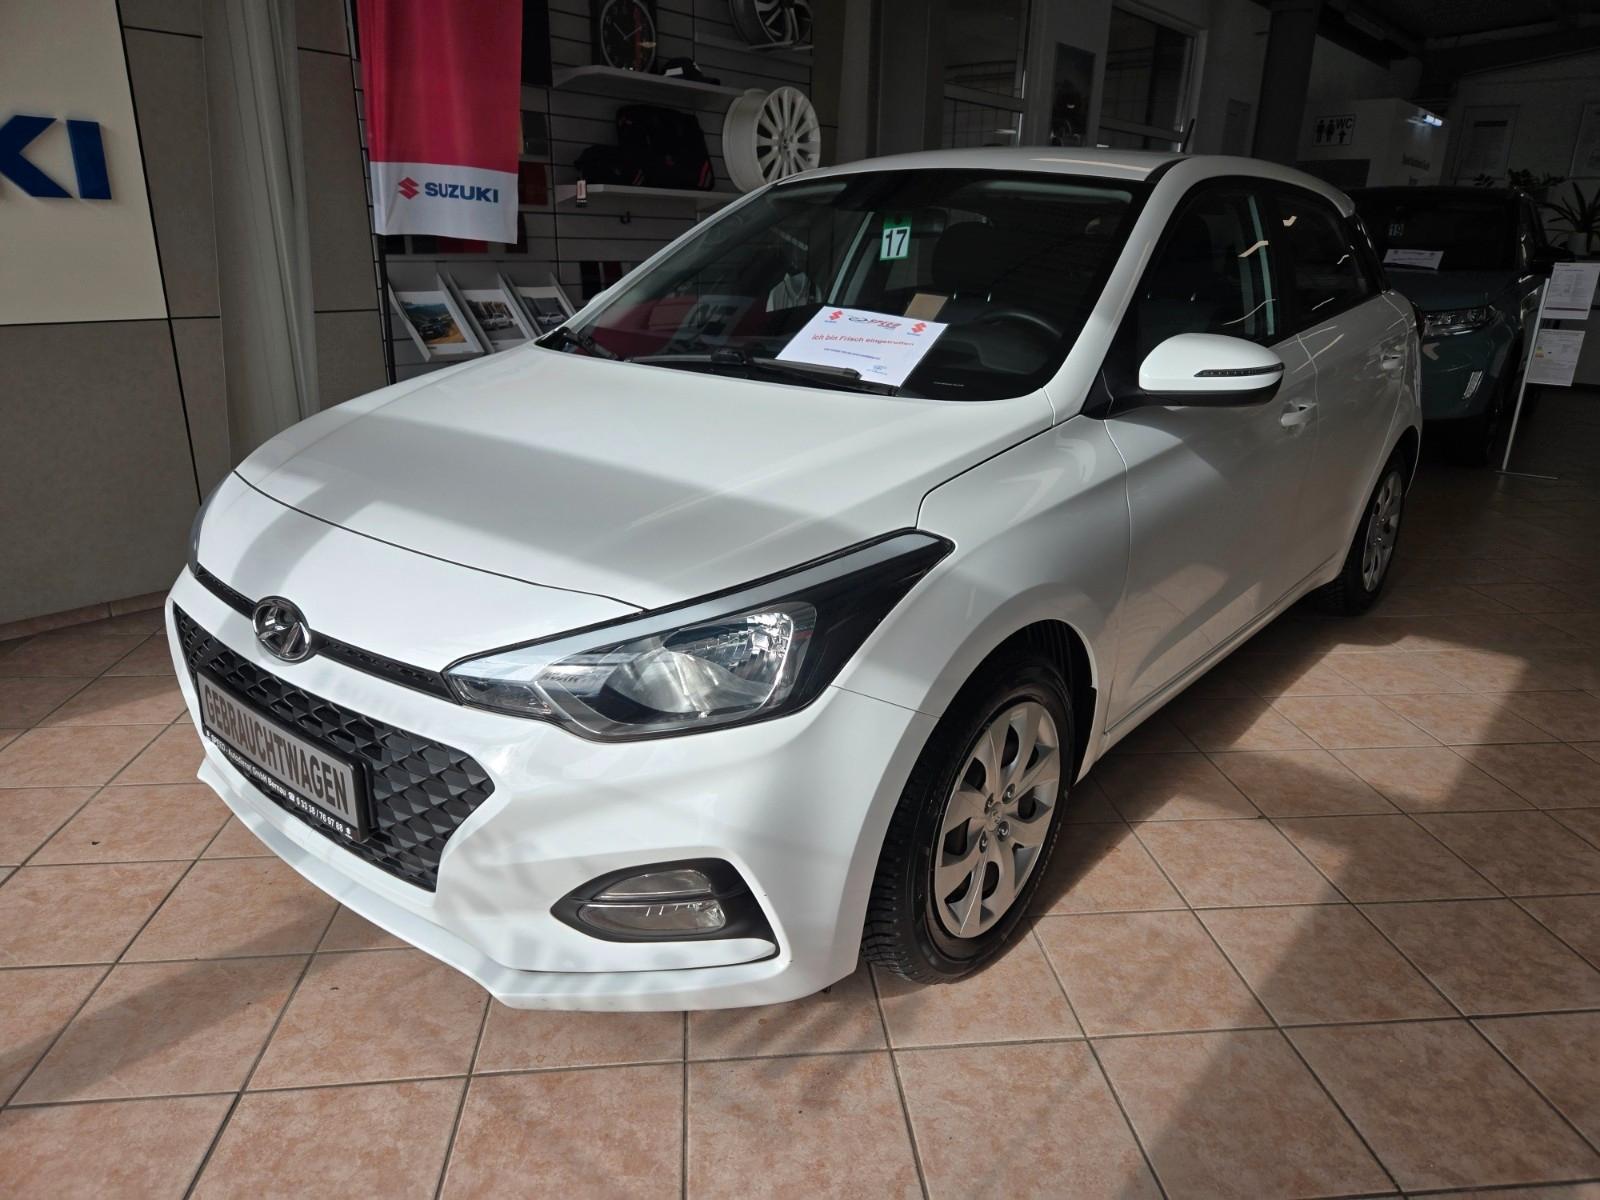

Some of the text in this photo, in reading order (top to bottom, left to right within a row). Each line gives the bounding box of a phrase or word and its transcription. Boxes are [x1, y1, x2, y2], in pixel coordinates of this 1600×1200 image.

[1335, 118, 1353, 129] WC
[425, 182, 499, 203] SUZUKI
[885, 228, 908, 257] 17
[204, 684, 350, 815] GEBRAUCHTWAGEN
